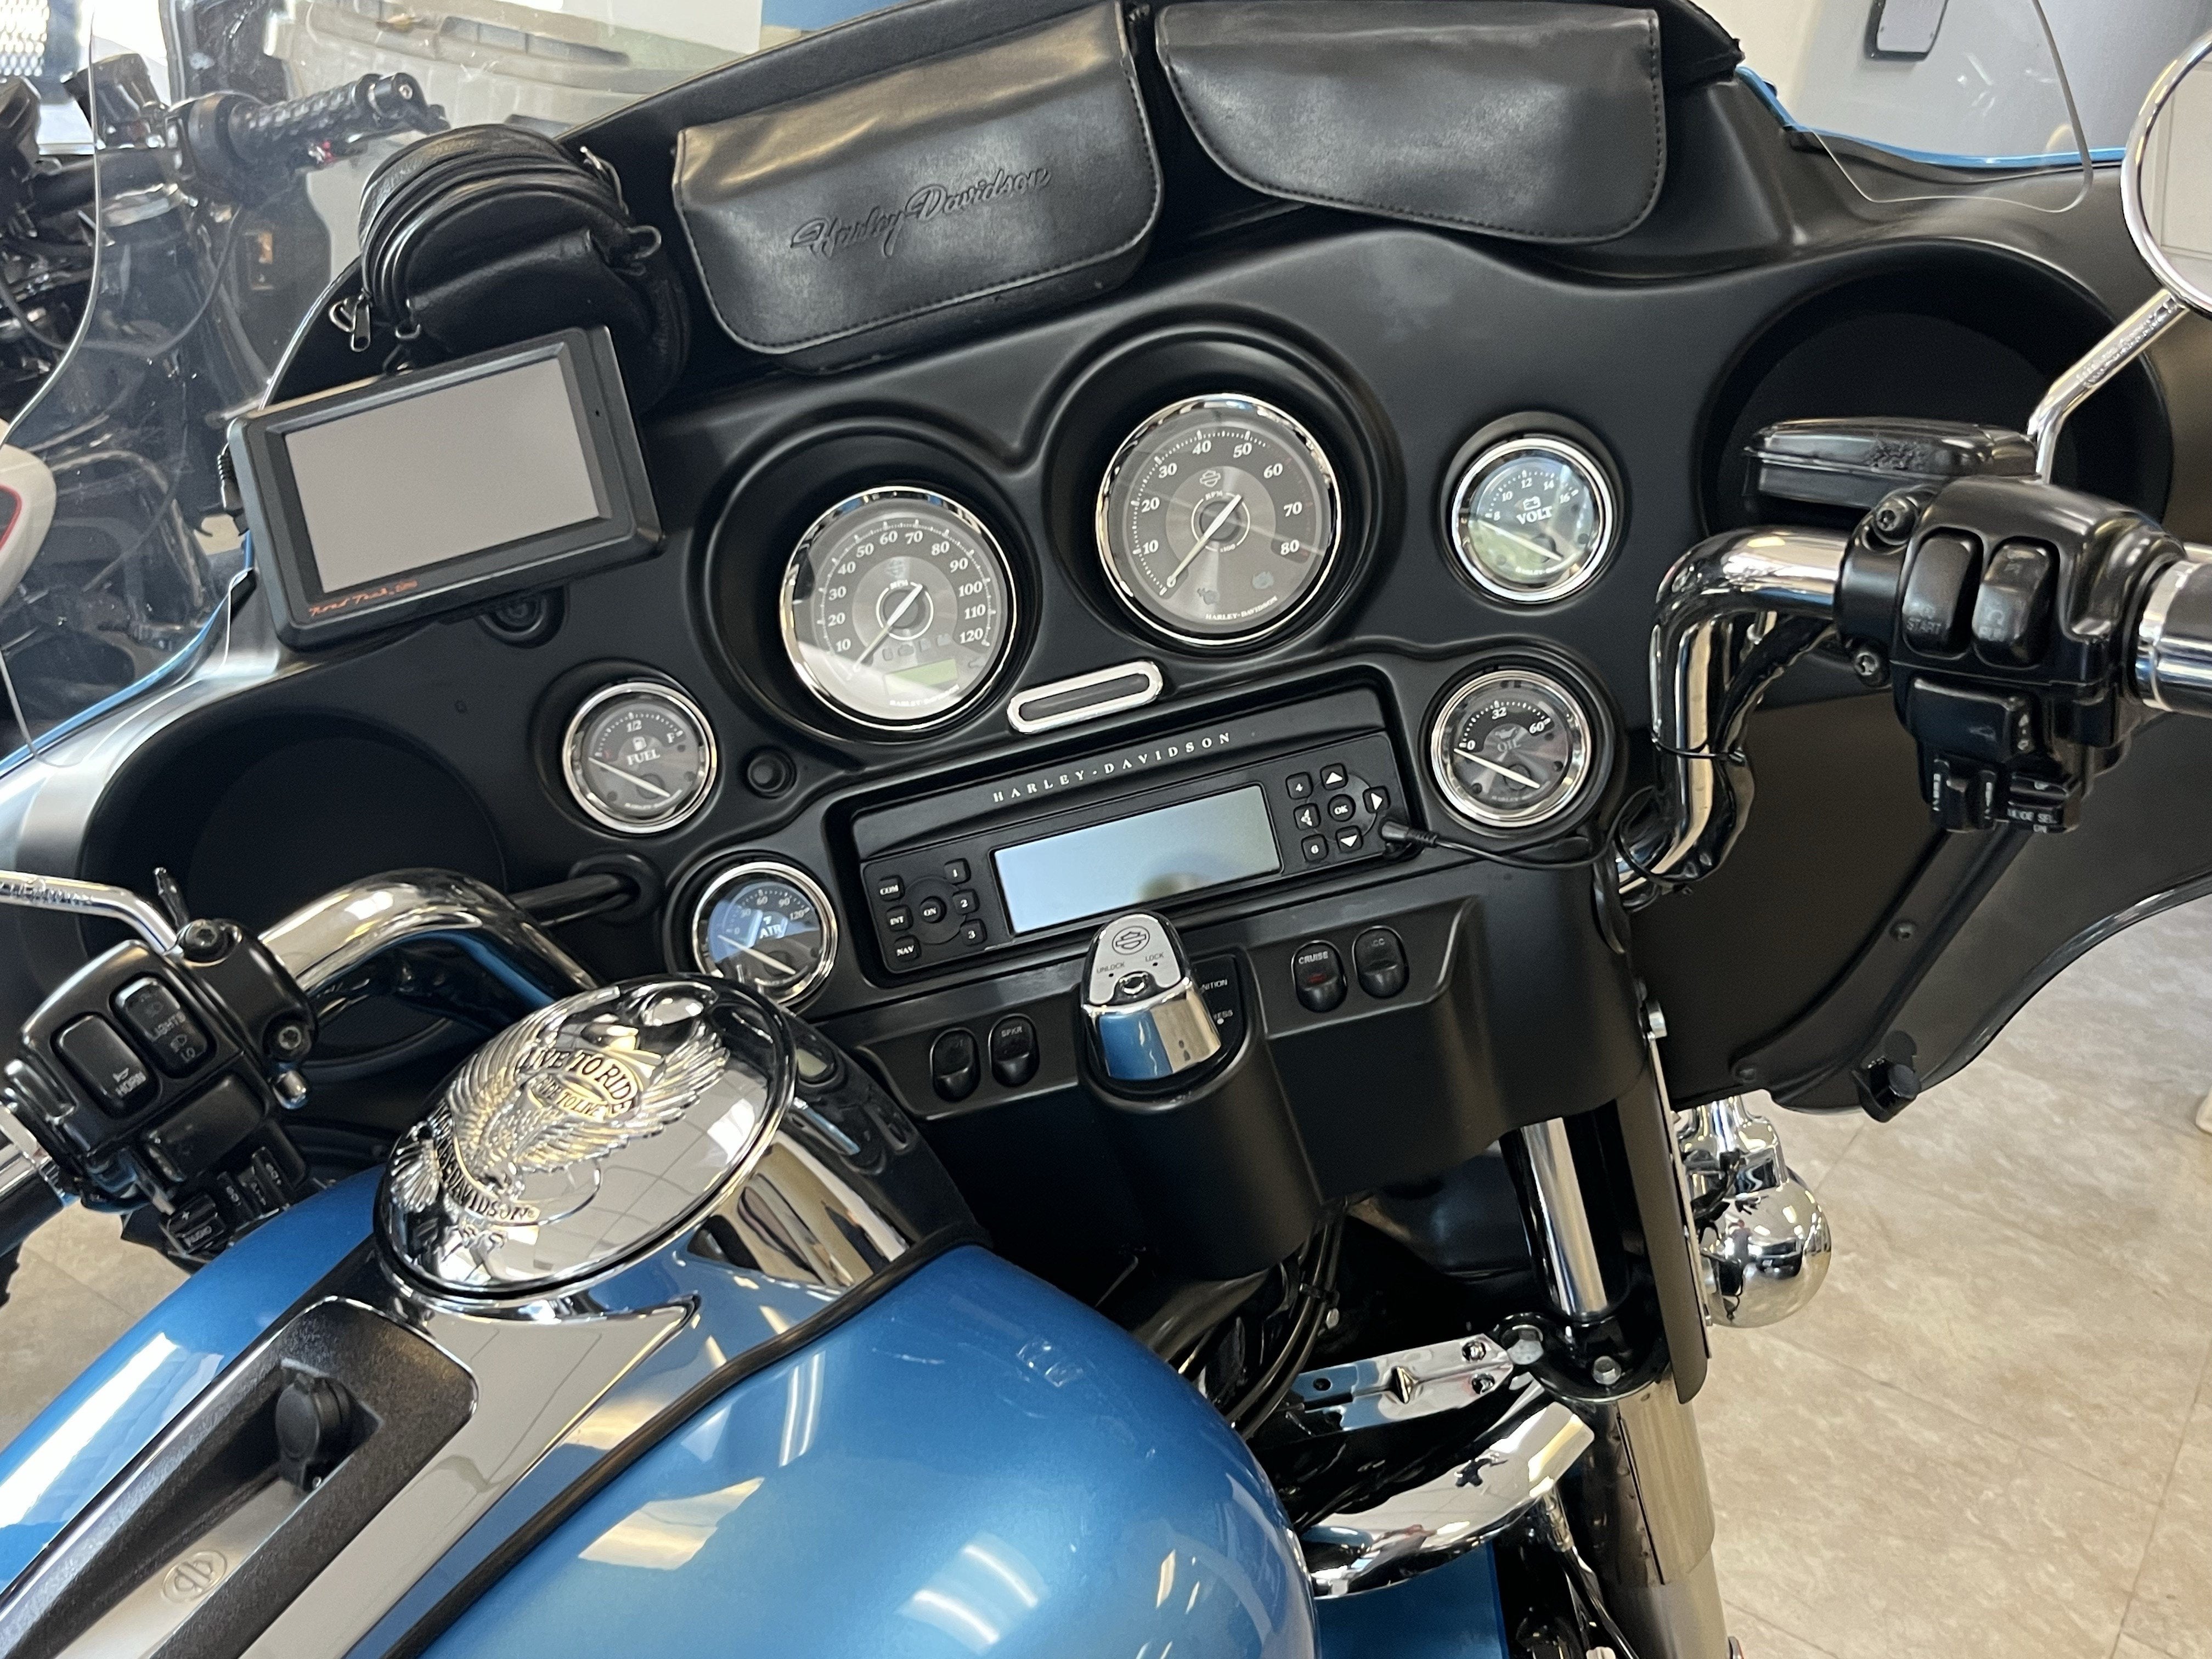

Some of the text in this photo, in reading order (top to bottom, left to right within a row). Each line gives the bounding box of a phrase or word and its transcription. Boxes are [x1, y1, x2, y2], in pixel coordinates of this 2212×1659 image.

[1192, 440, 1212, 454] 40
[1233, 443, 1252, 458] 50
[1158, 462, 1178, 479] 30
[1263, 462, 1283, 479] 60
[1521, 478, 1533, 489] 12
[1543, 480, 1555, 490] 14
[1502, 492, 1514, 502] 10
[1559, 494, 1571, 504] 16
[1142, 497, 1160, 512] 20
[1283, 501, 1302, 516] 70
[1493, 510, 1501, 521] 8
[1516, 506, 1553, 525] VOLT
[879, 530, 898, 545] 60
[905, 530, 924, 544] 70
[856, 543, 874, 558] 50
[931, 540, 950, 555] 80
[1143, 540, 1159, 554] 10
[1280, 539, 1300, 555] 80
[838, 561, 856, 575] 40
[950, 557, 969, 573] 90
[828, 585, 847, 600] 30
[958, 582, 983, 597] 100
[827, 612, 847, 627] 20
[964, 605, 986, 620] 110
[1906, 617, 1942, 635] START
[960, 627, 984, 644] 120
[836, 638, 851, 652] 10
[1491, 707, 1507, 720] 32
[627, 720, 642, 732] 1/2
[1529, 721, 1545, 733] 60
[667, 732, 675, 743] F
[1466, 740, 1476, 751] 0
[1497, 739, 1521, 753] OIL
[627, 749, 661, 765] FUEL
[992, 731, 1232, 804] HARLEY-DAVIDSON
[1333, 804, 1348, 815] OK
[952, 869, 958, 878] 1
[879, 884, 899, 895] COM
[757, 896, 768, 905] 60
[778, 898, 790, 908] 90
[960, 899, 969, 908] 2
[789, 909, 804, 921] 120
[923, 907, 937, 916] ON
[889, 915, 905, 926] INT
[759, 923, 782, 939] AIR
[968, 930, 976, 939] 3
[896, 944, 915, 957] NAV
[1145, 951, 1164, 962] LOCK
[1298, 950, 1329, 966] CRUISE
[1096, 961, 1125, 974] UNLOCK
[153, 1011, 186, 1042] LIGHTS
[1001, 1025, 1023, 1038] SPKR
[115, 1070, 147, 1097] HORN
[515, 1047, 635, 1115] LIVE TO RIDE
[555, 1091, 578, 1108] TO
